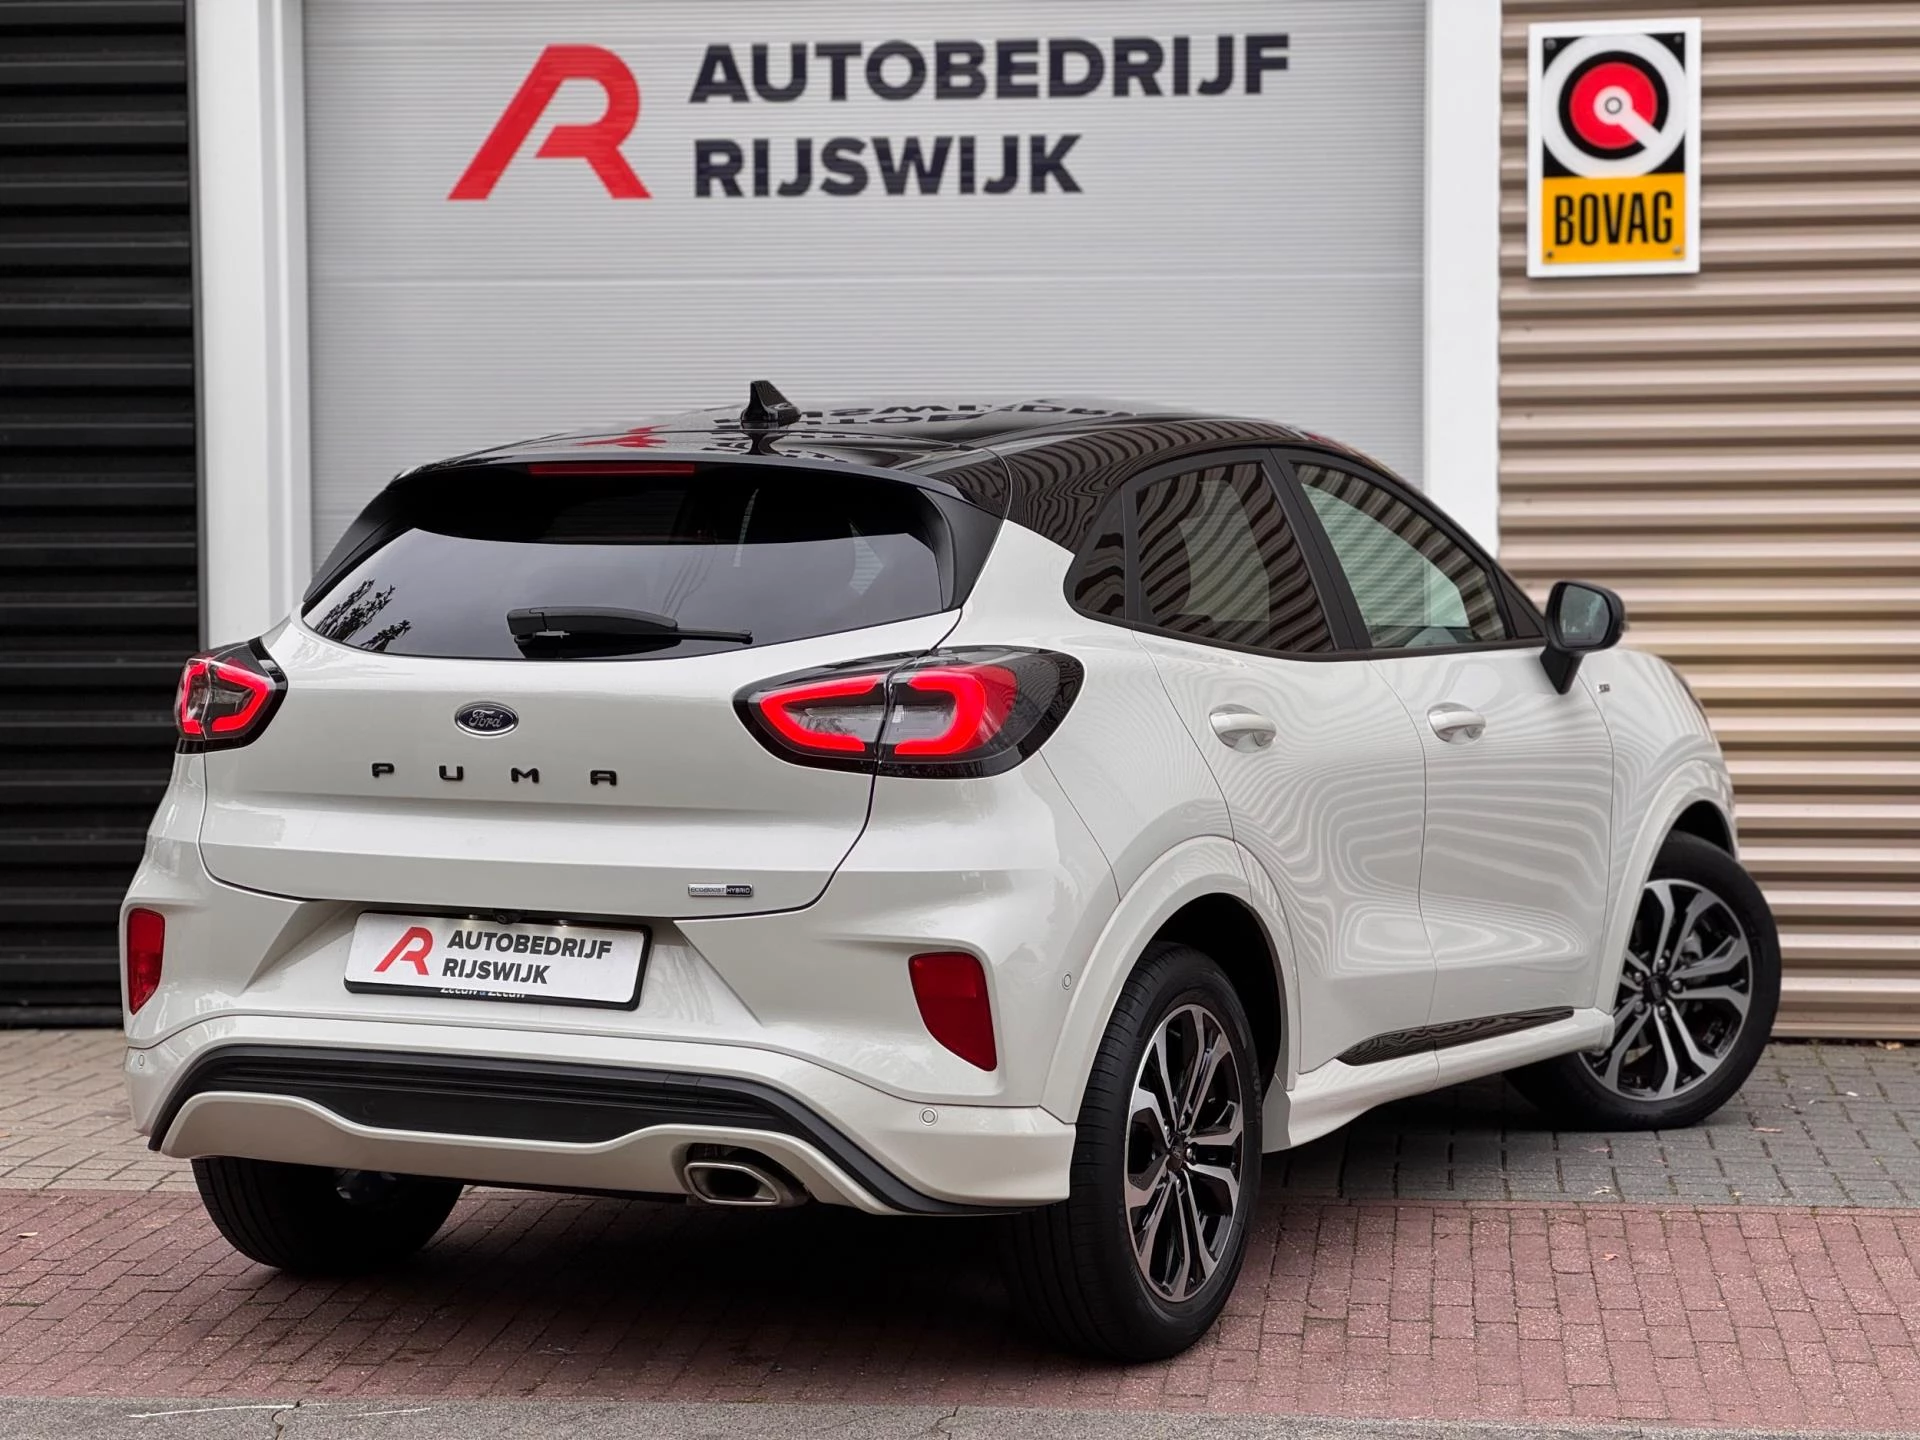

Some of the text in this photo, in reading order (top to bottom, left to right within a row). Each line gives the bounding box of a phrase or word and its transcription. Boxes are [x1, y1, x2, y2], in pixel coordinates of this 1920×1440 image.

[689, 34, 1290, 103] AUTOBEDRIJF
[694, 134, 1082, 198] RIJSWIJK
[1554, 191, 1673, 246] BOVAG
[468, 708, 504, 728] Ford
[371, 762, 617, 786] PUMA
[447, 930, 613, 960] AUTOBEDRIJF
[442, 958, 551, 985] RIJSWIJK
